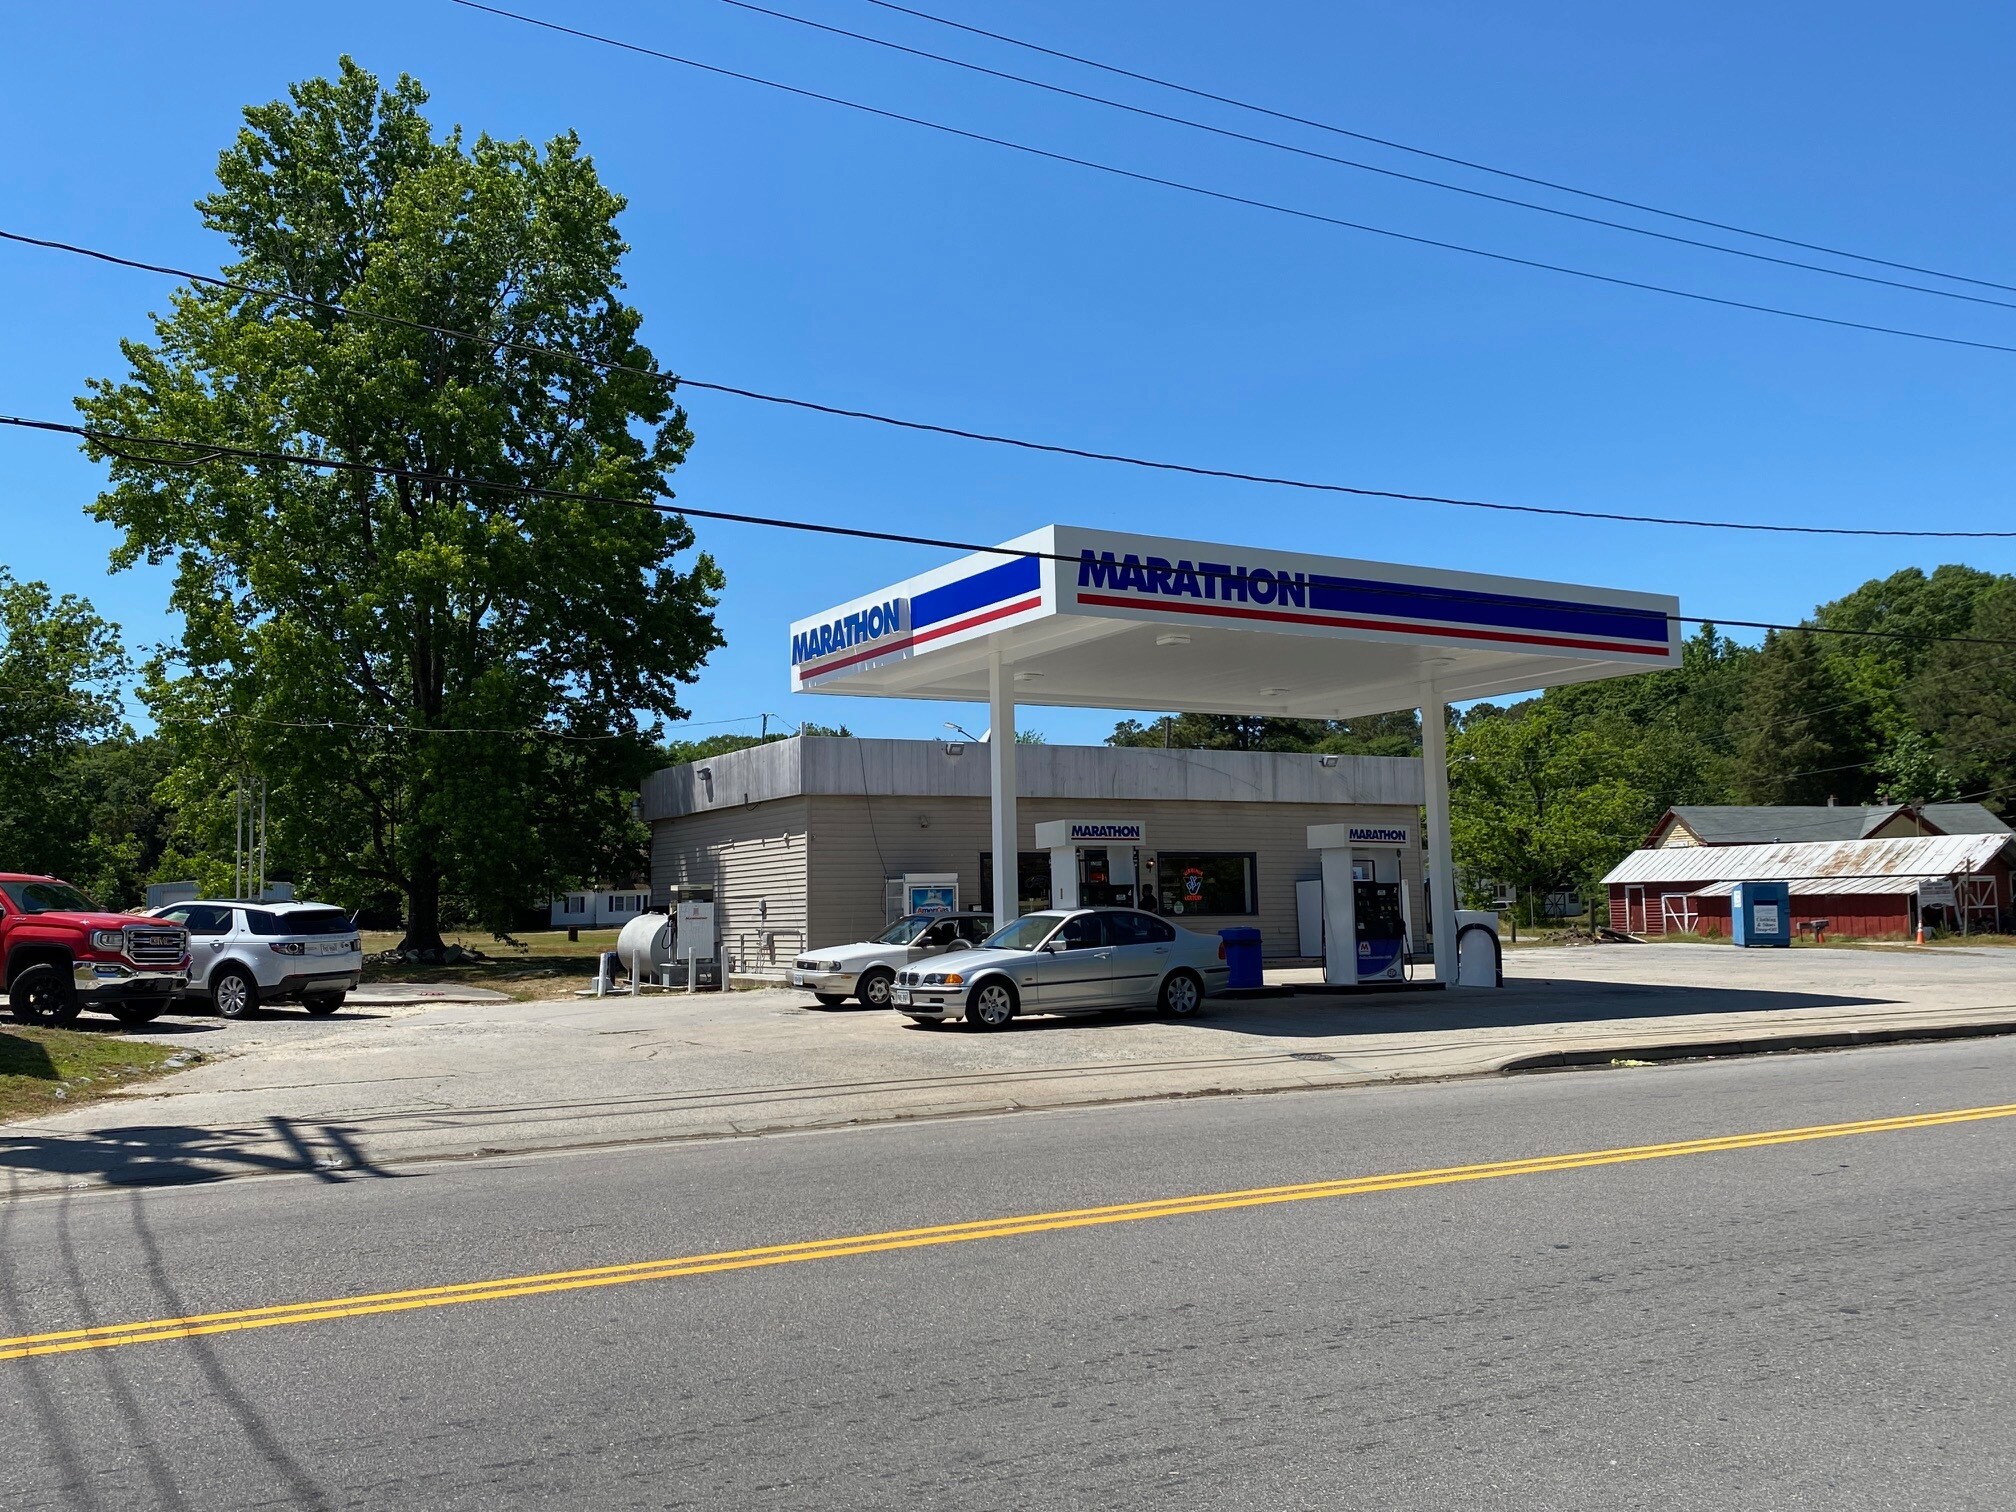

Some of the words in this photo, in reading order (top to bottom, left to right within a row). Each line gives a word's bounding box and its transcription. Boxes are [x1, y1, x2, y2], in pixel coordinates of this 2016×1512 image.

[1077, 549, 1305, 608] MARATHON
[792, 598, 899, 666] MARATHON
[1071, 825, 1140, 837] MARATHON
[1349, 829, 1406, 840] MARATHON
[150, 936, 173, 945] GMC
